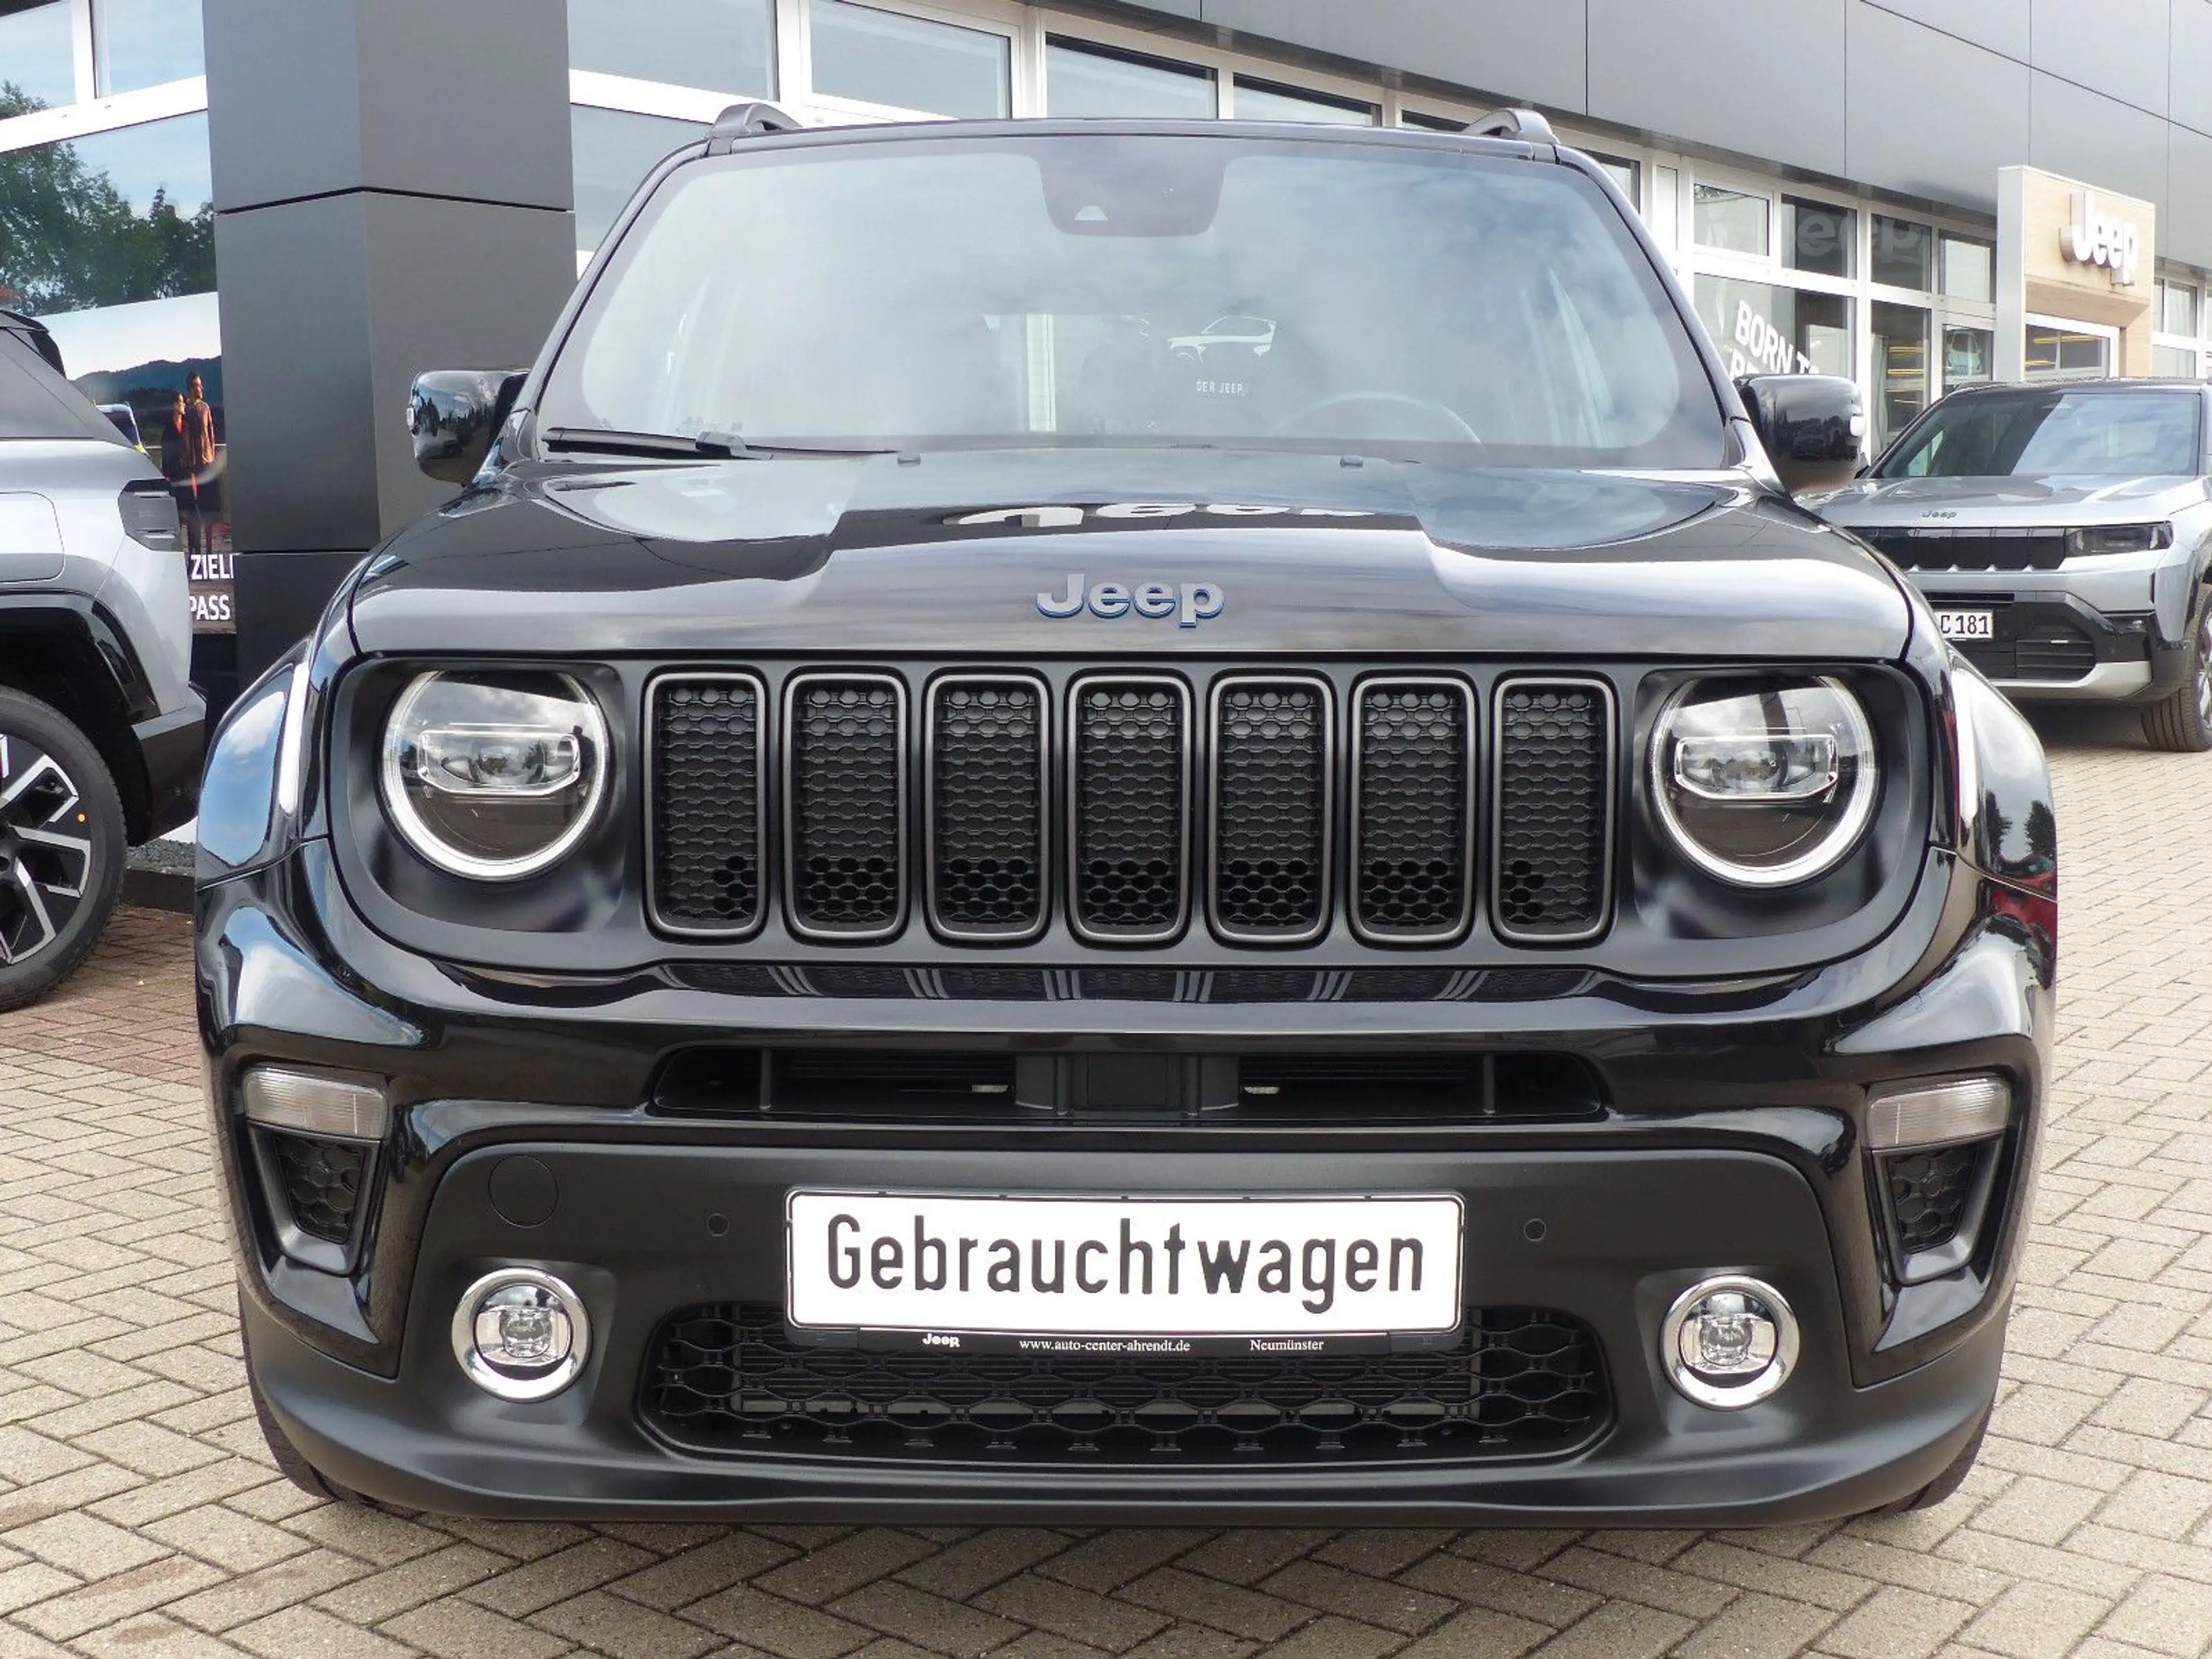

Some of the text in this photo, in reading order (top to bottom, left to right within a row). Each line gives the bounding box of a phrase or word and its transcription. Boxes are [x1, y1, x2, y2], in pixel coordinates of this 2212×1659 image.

[2059, 190, 2138, 283] Jeep
[1735, 305, 1794, 373] BORN
[1797, 351, 1819, 374] T
[1196, 381, 1243, 395] DER JEEP
[1921, 510, 1957, 519] Jeep
[1036, 574, 1225, 628] Jeep
[1955, 615, 1989, 635] 181
[827, 1213, 1424, 1315] Gebrauchtwagen
[1019, 1339, 1191, 1351] www.auto-center-ahrendt.de
[1249, 1339, 1324, 1351] Neumünster
